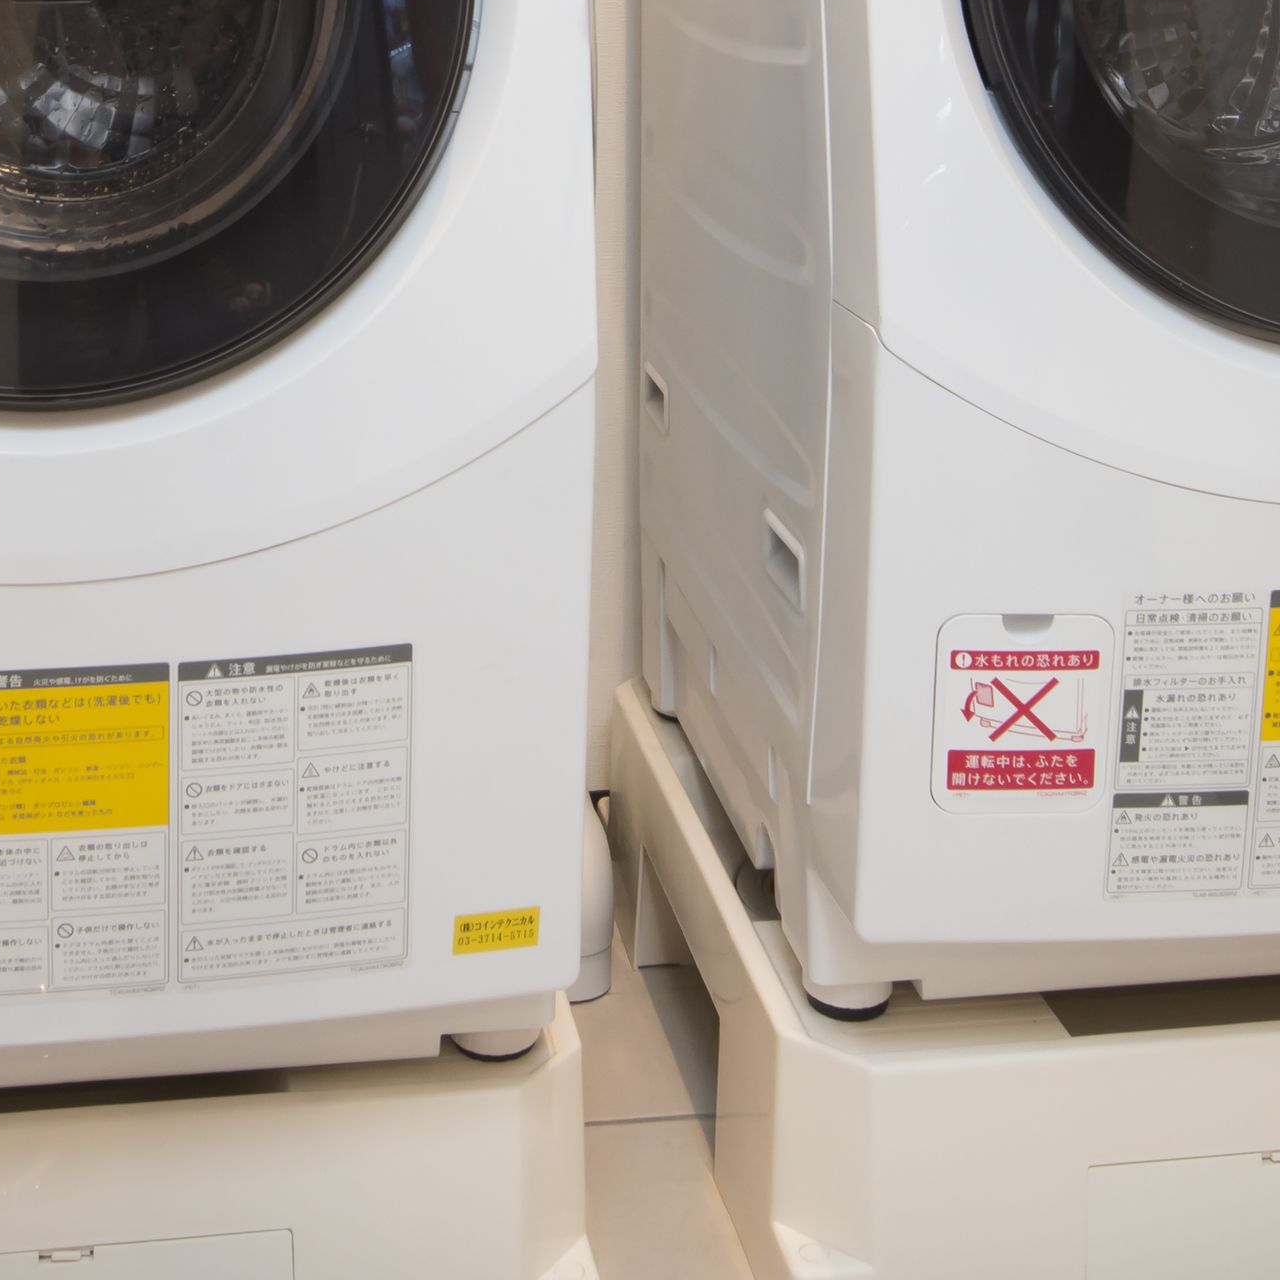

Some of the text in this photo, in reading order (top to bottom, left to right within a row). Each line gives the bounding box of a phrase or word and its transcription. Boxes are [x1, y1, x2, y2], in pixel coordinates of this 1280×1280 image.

[975, 654, 1094, 667] 水もれの恐れあり
[229, 663, 256, 676] 注意
[965, 755, 1078, 769] 運転中は、ふたを
[952, 773, 1088, 785] 開けないでください。
